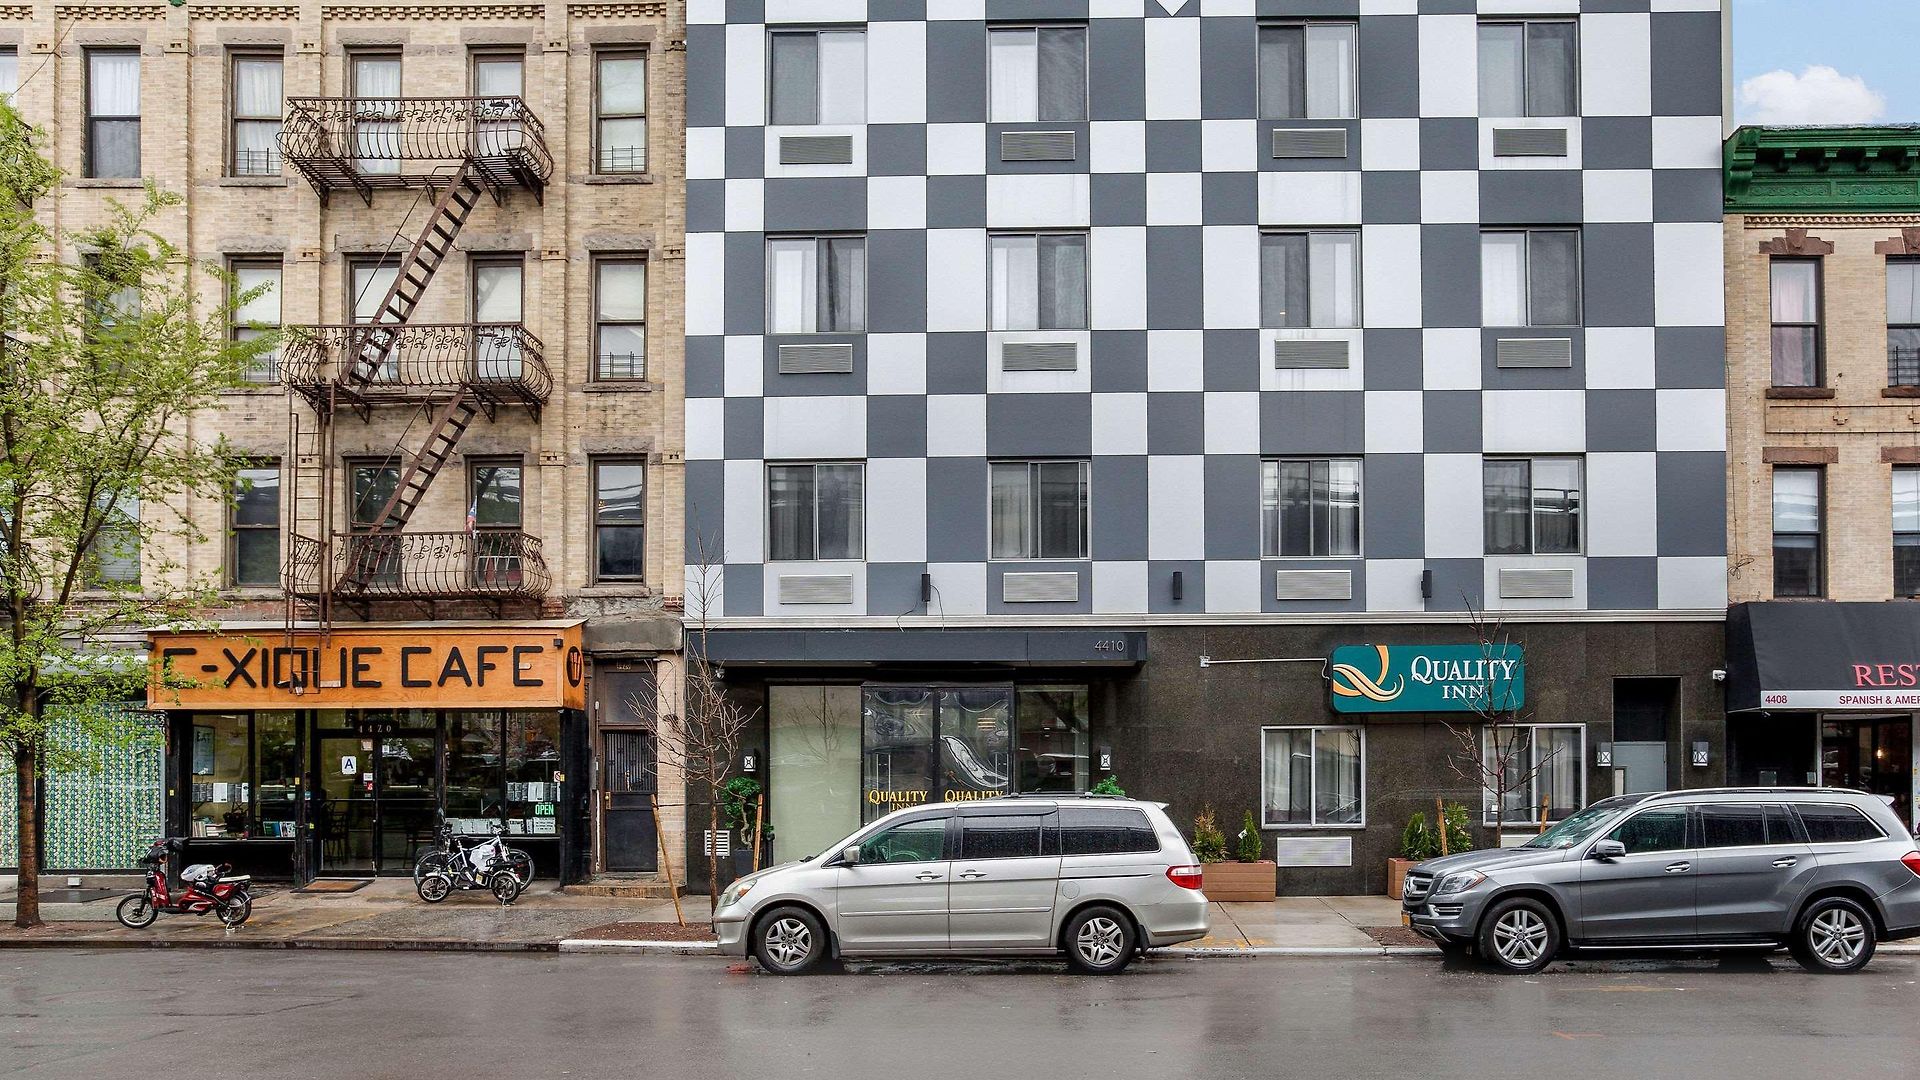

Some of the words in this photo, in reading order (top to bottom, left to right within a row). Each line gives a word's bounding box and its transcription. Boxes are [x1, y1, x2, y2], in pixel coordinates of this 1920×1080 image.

[1094, 640, 1125, 652] 4410
[402, 646, 544, 688] CAFE
[1411, 655, 1516, 685] QUALITY
[1852, 664, 1920, 687] RES
[1442, 685, 1485, 699] INN
[1765, 695, 1788, 704] 4408
[1839, 695, 1883, 705] SPANISH
[1885, 695, 1893, 705] &
[344, 758, 354, 770] A
[868, 789, 929, 805] QUALITY
[534, 803, 555, 816] OPEN
